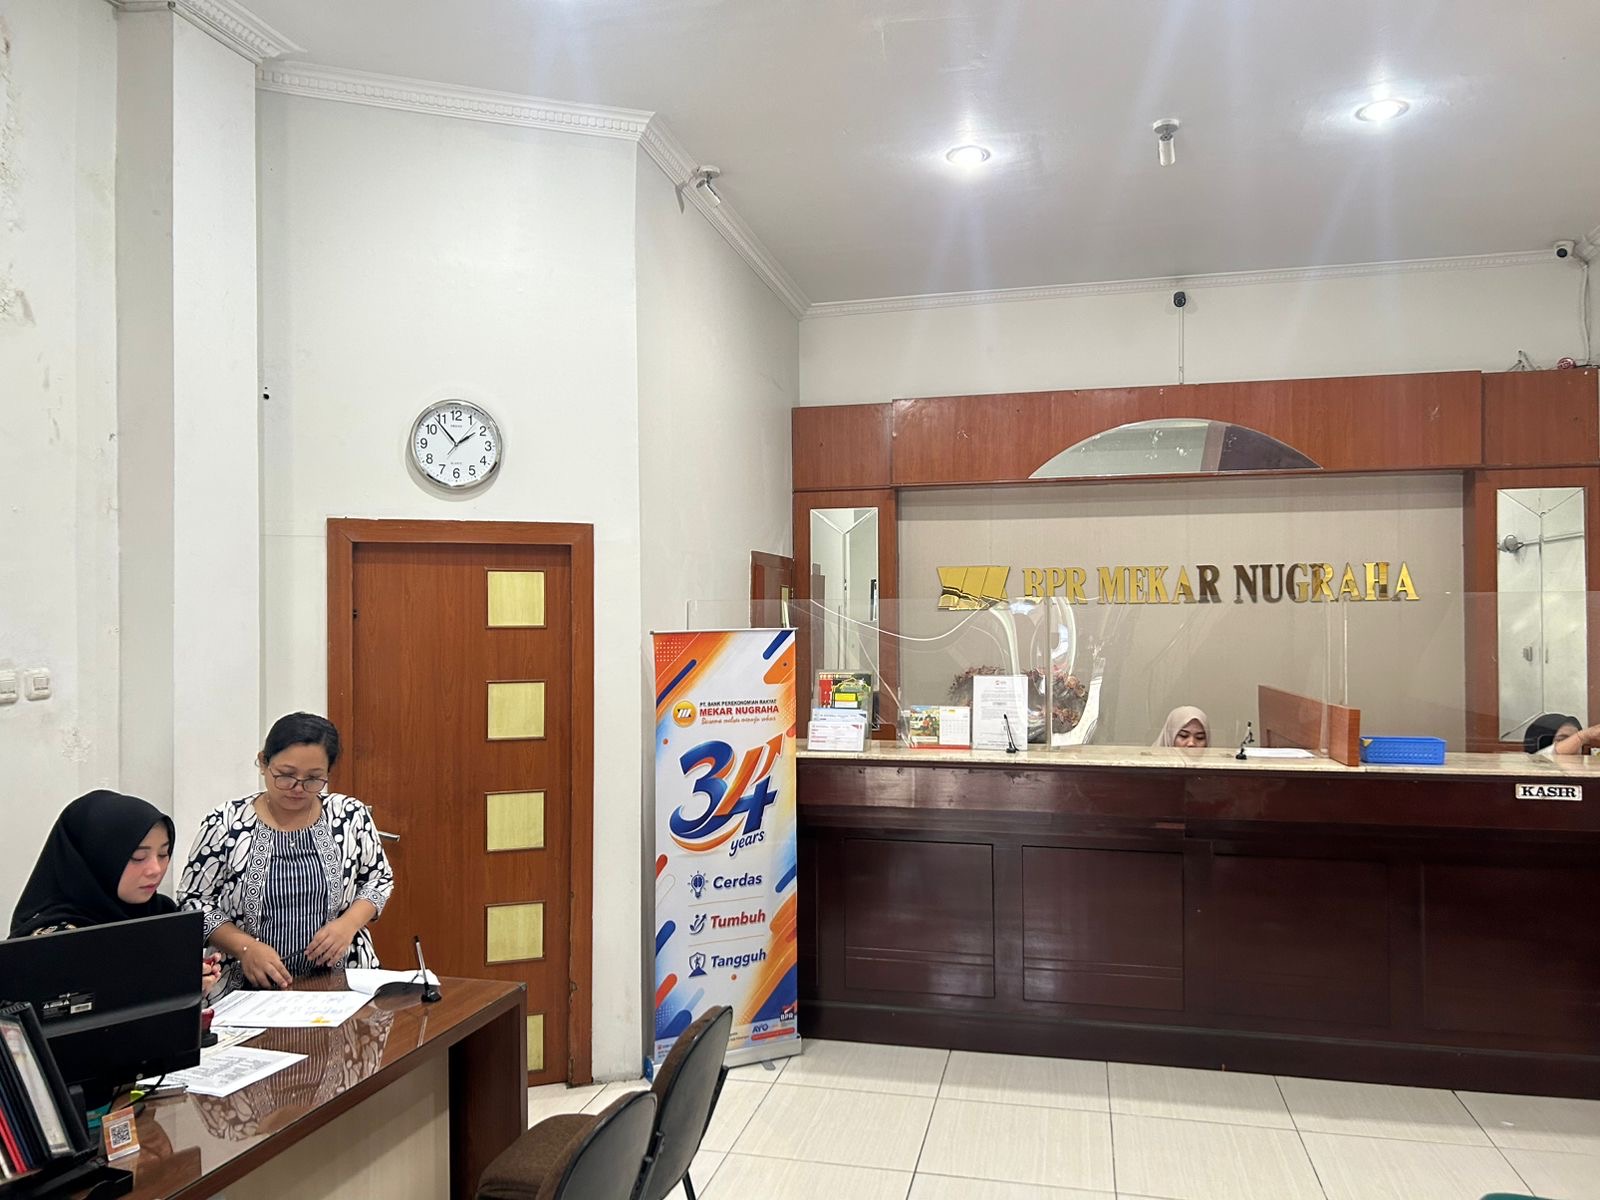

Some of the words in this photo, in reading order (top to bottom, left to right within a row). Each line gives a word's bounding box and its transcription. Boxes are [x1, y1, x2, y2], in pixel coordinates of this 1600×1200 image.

[437, 414, 446, 424] 11
[450, 410, 462, 421] 12
[468, 415, 472, 425] 1
[426, 424, 437, 435] 10
[480, 426, 487, 436] 2
[420, 438, 428, 448] 9
[485, 441, 492, 451] 3
[426, 453, 433, 464] 8
[480, 456, 487, 466] 4
[439, 464, 446, 474] 7
[453, 468, 460, 478] 6
[469, 465, 476, 476] 5
[1022, 567, 1088, 605] BPR
[1096, 564, 1221, 605] MEKAR
[1233, 561, 1420, 604] NUGRAHA
[700, 708, 733, 716] MEKAR
[736, 706, 779, 715] NUGRAHA
[669, 733, 783, 840] 34
[1521, 786, 1576, 798] KASIR
[729, 831, 765, 857] years
[713, 872, 763, 890] Cerdas
[710, 909, 766, 929] Tumbuh
[711, 948, 766, 969] Tangguh
[752, 1023, 769, 1034] AYO
